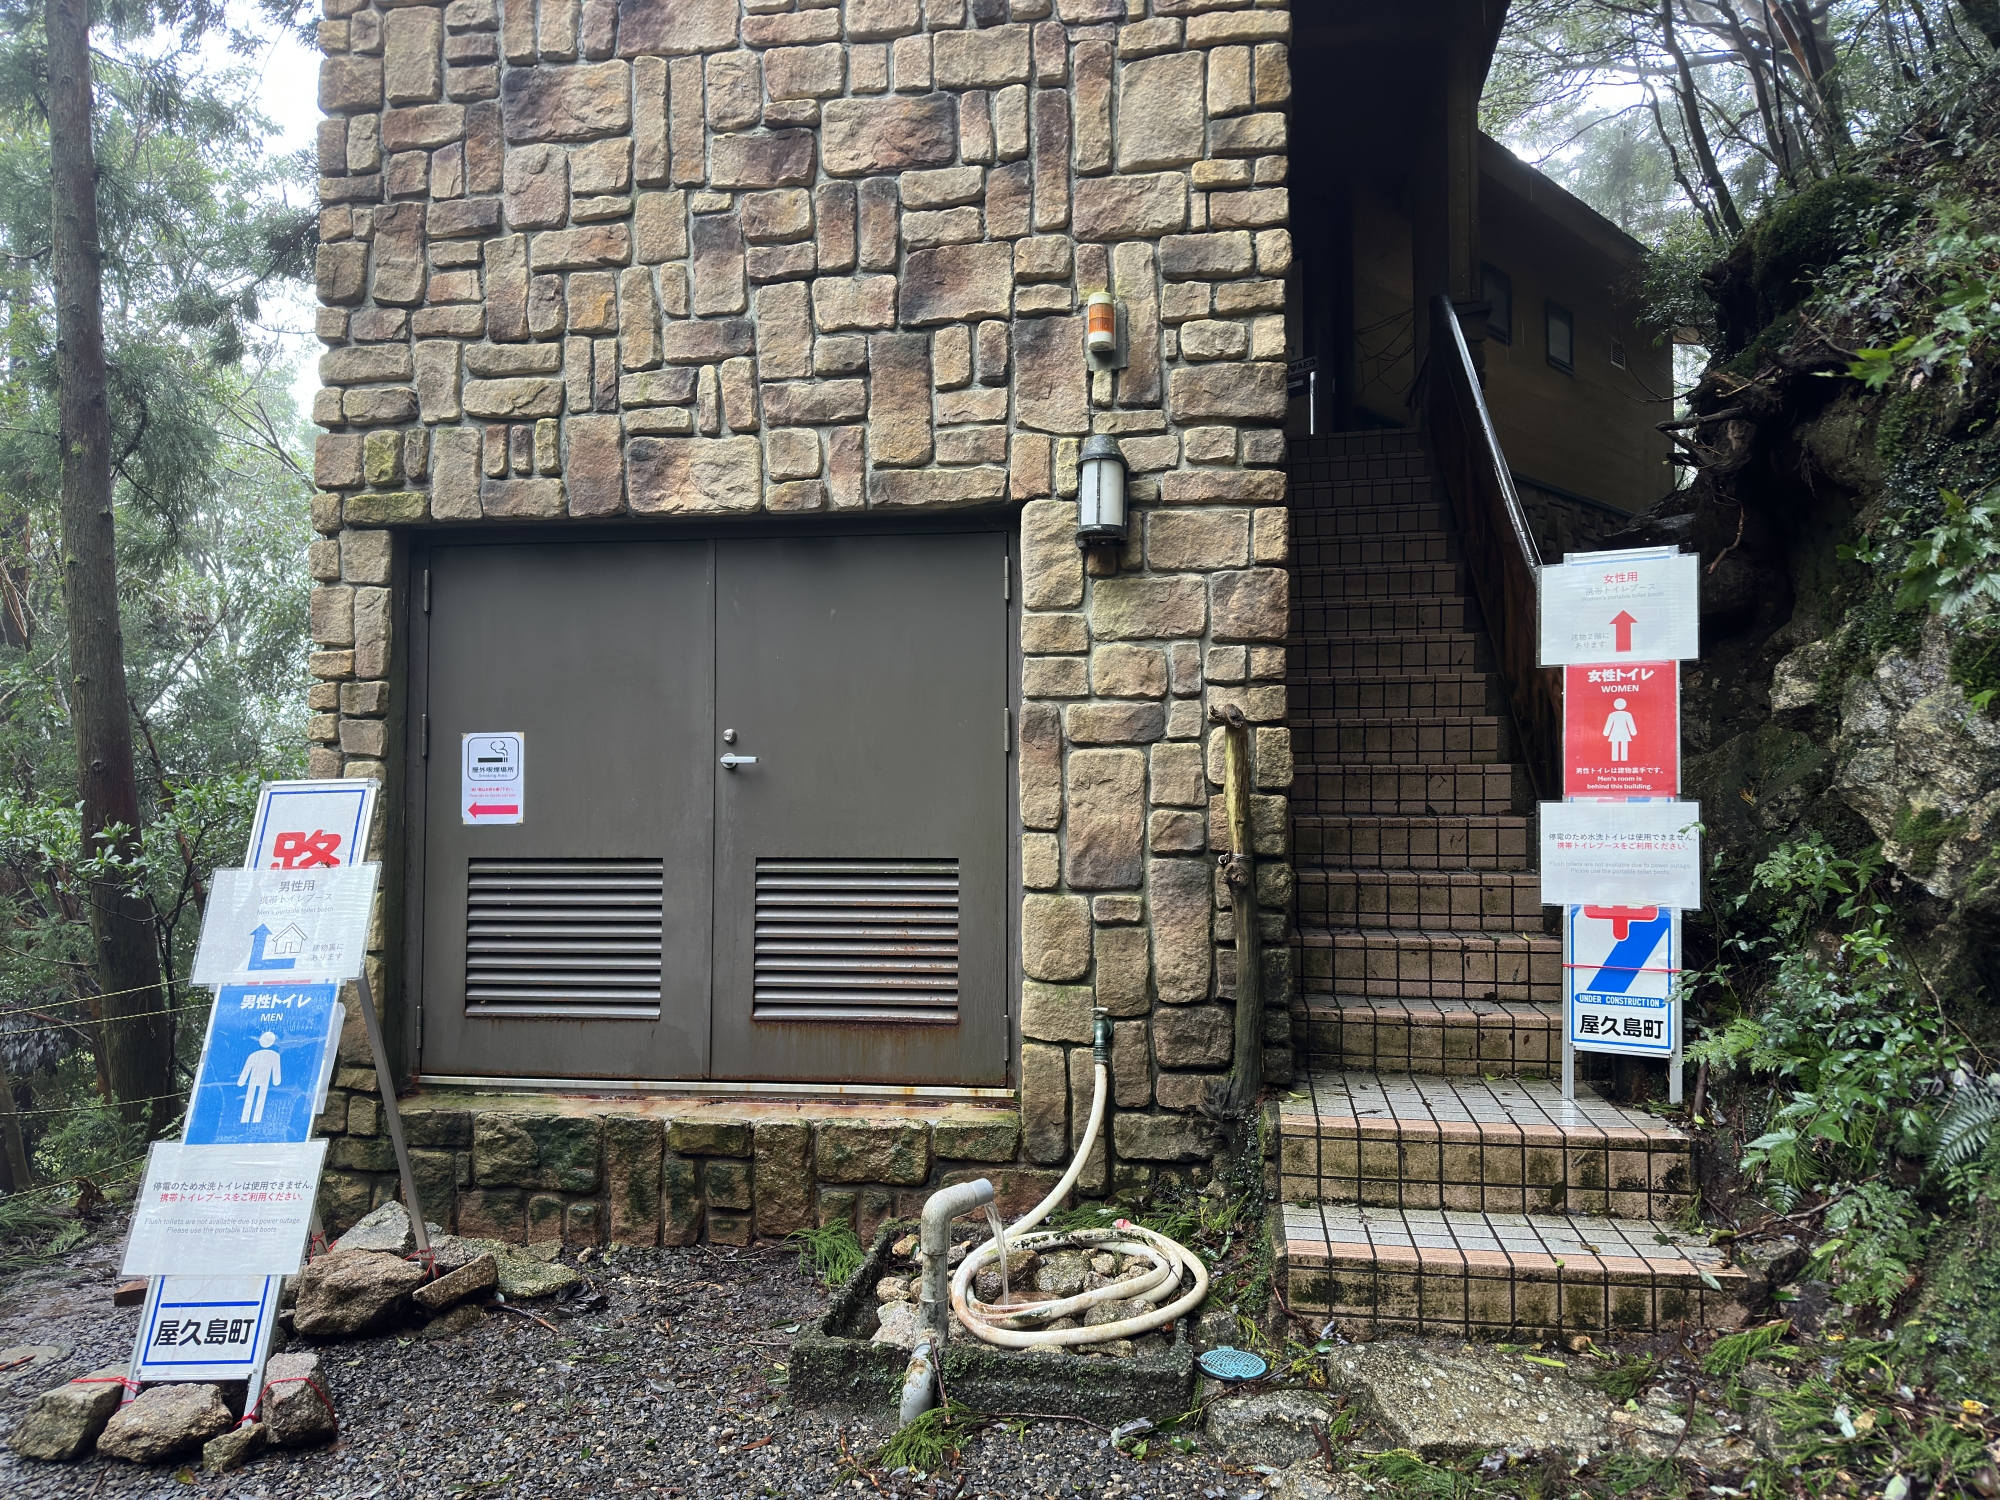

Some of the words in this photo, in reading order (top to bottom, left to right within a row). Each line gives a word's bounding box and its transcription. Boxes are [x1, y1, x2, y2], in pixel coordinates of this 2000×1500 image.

[1297, 358, 1316, 370] AED
[1603, 572, 1638, 584] 女性用
[1586, 584, 1656, 596] 携帯トイレブース
[1575, 641, 1606, 650] あります
[1588, 668, 1654, 682] 女性トイレ
[1601, 684, 1639, 693] WOMEN
[1549, 833, 1696, 841] 停電のため水洗トイレは使用できません。
[1557, 842, 1688, 850] 携帯トイレブースをご利用ください。
[279, 880, 315, 892] 男性用
[312, 953, 343, 961] あります
[240, 994, 312, 1009] 男性トイレ
[1579, 994, 1602, 1004] UNDER
[1606, 995, 1660, 1008] CONSTRUCTION
[260, 1013, 283, 1021] MEN
[1580, 1014, 1664, 1039] 屋久島町
[153, 1180, 314, 1191] 停電のため水洗トイレは使用できません。
[159, 1192, 303, 1202] 携帯トイレブースをご利用ください。
[153, 1318, 255, 1346] 屋久島町
